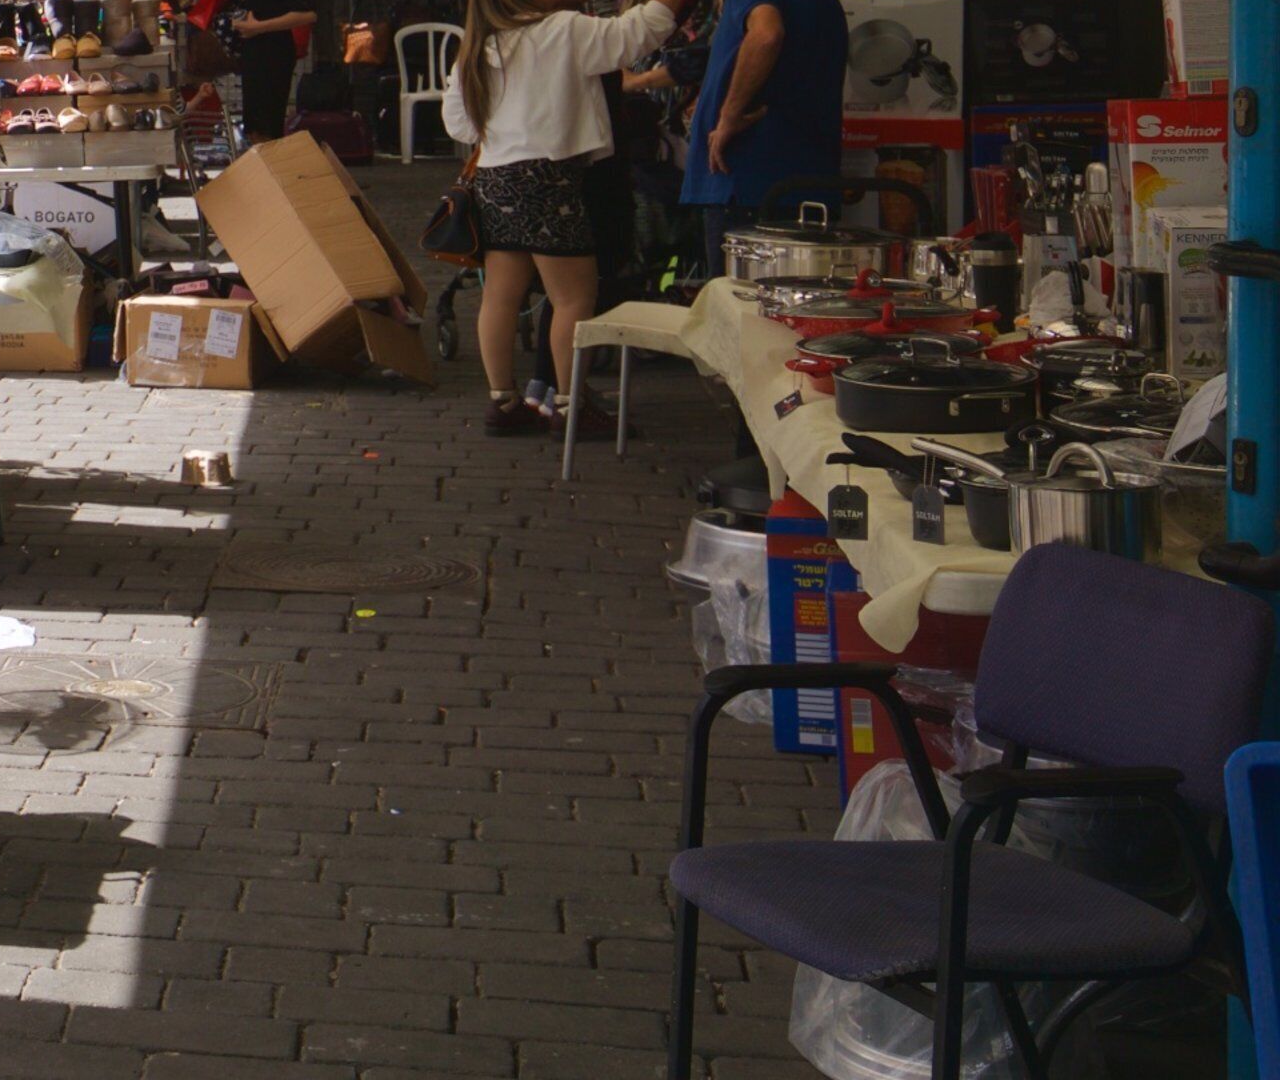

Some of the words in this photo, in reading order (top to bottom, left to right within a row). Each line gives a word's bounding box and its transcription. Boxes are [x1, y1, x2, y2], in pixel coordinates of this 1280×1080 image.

[1163, 125, 1222, 137] Selmor
[34, 211, 95, 223] BOGATO
[1177, 233, 1227, 242] KENNED
